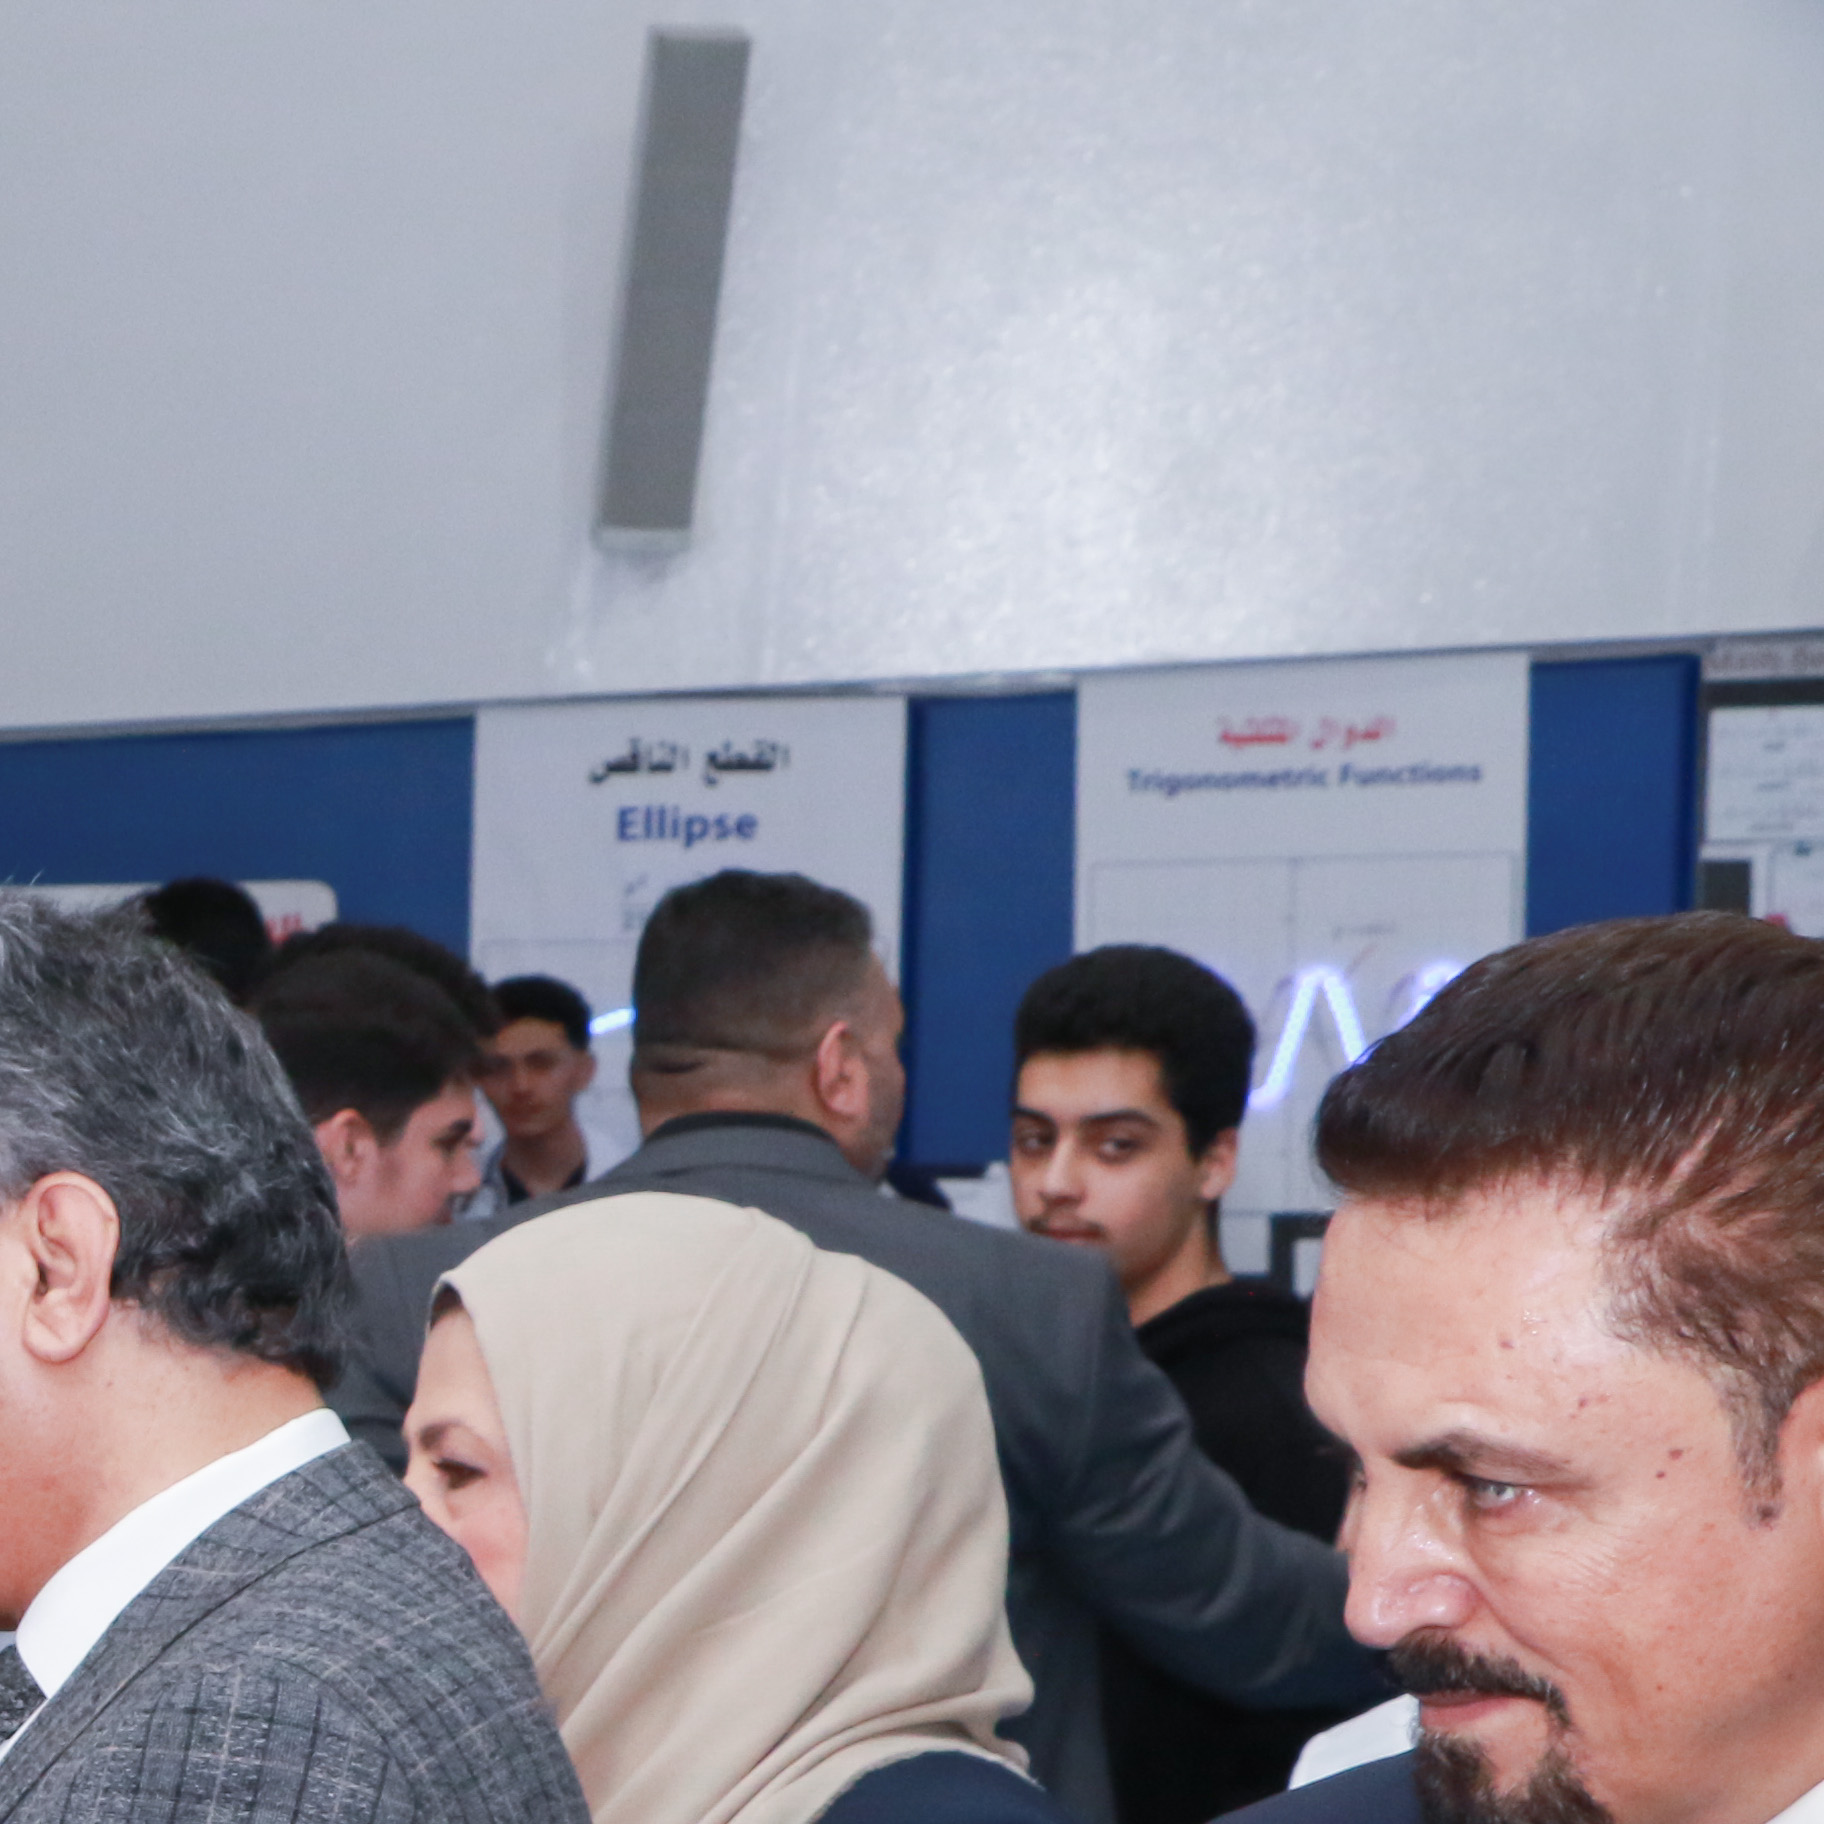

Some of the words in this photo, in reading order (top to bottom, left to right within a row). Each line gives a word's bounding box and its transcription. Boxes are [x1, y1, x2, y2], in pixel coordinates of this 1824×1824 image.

[1128, 768, 1329, 799] Trigonometric
[1338, 762, 1483, 788] Functions
[616, 805, 758, 850] Ellipse
